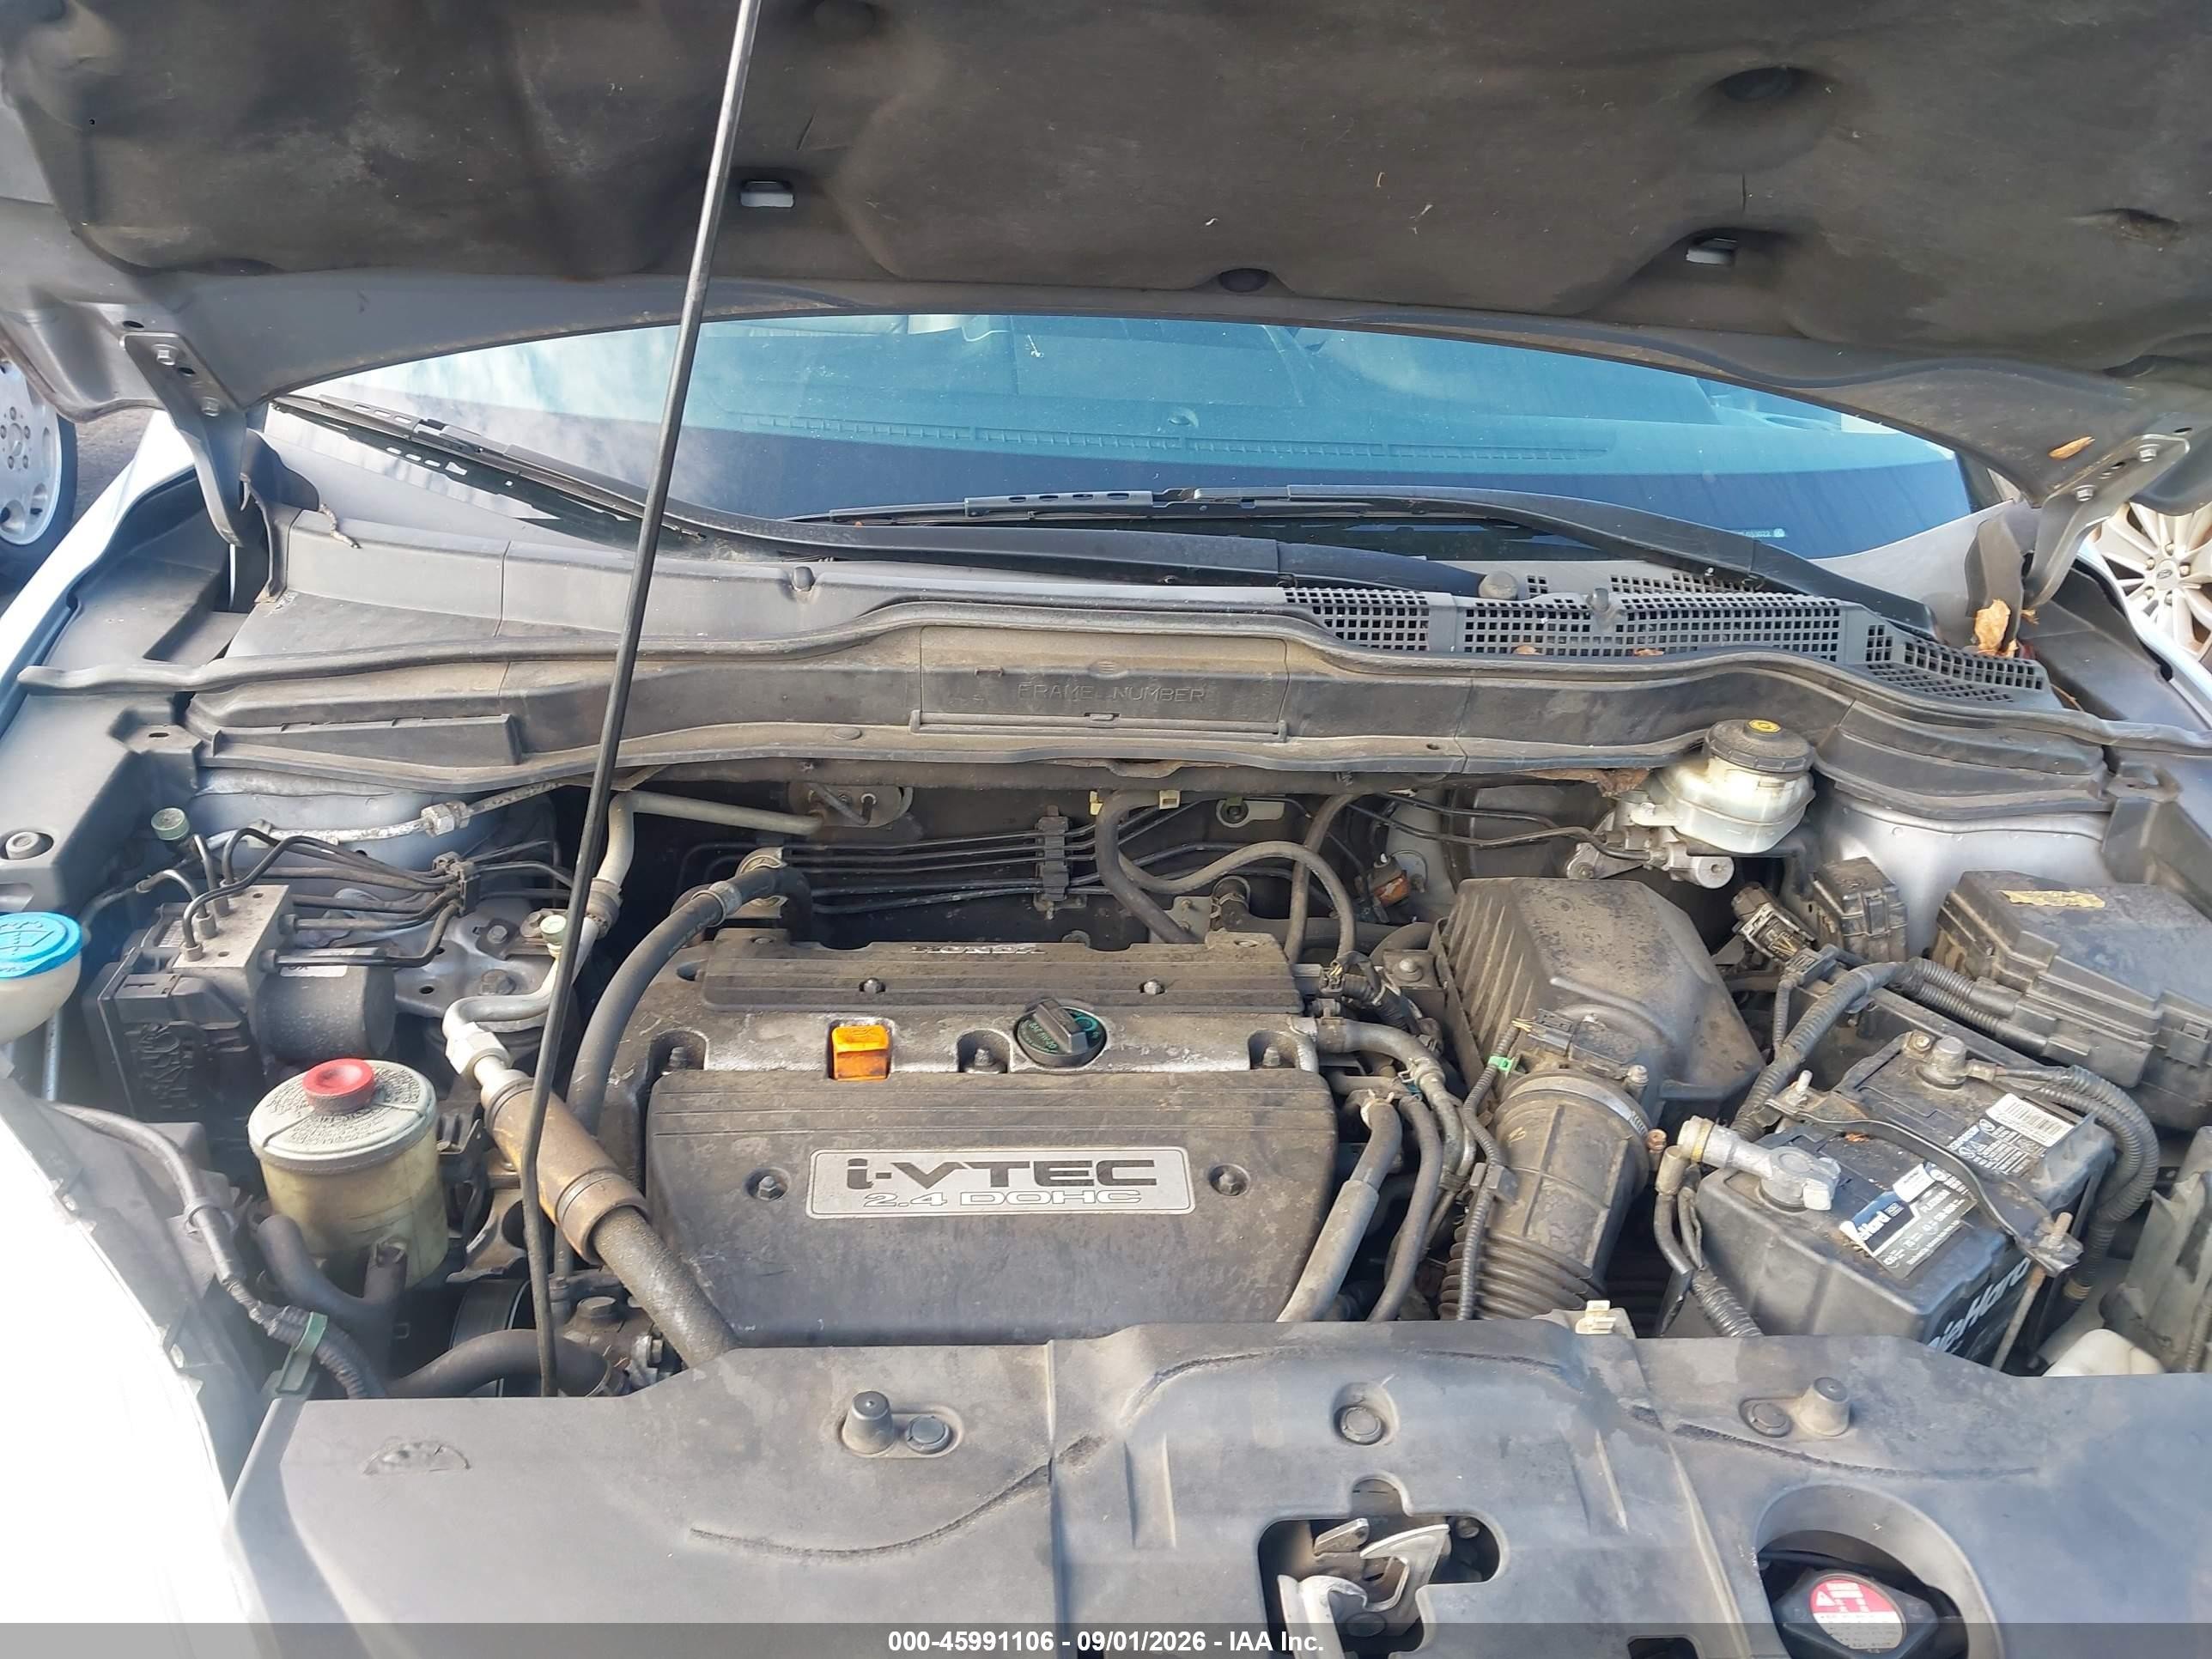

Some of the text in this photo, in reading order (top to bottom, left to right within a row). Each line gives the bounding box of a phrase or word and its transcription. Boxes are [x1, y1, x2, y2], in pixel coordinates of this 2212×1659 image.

[1018, 684, 1206, 702] FRAME NUMBER
[847, 1158, 1157, 1190] i-VTEC
[862, 1189, 1142, 1208] 2.4 DOHC
